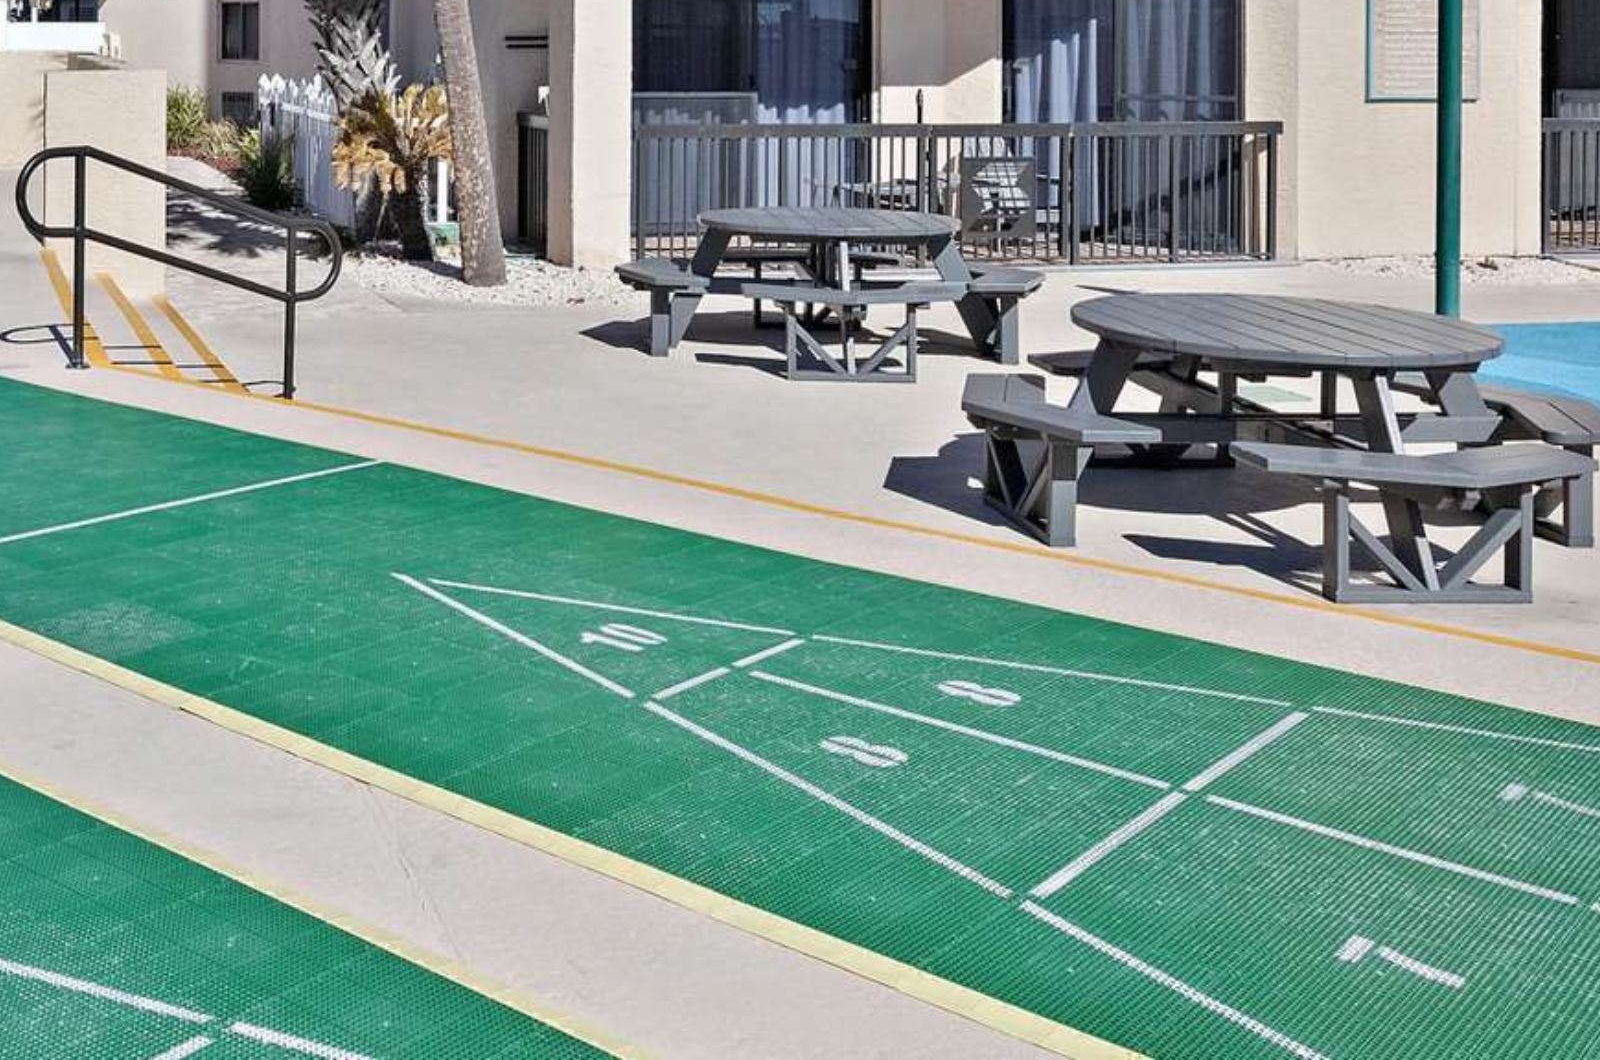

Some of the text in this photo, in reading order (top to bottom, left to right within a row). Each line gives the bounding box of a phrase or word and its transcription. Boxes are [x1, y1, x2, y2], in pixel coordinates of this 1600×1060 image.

[580, 623, 667, 652] 10
[936, 679, 1022, 707] 8
[819, 735, 909, 768] 8
